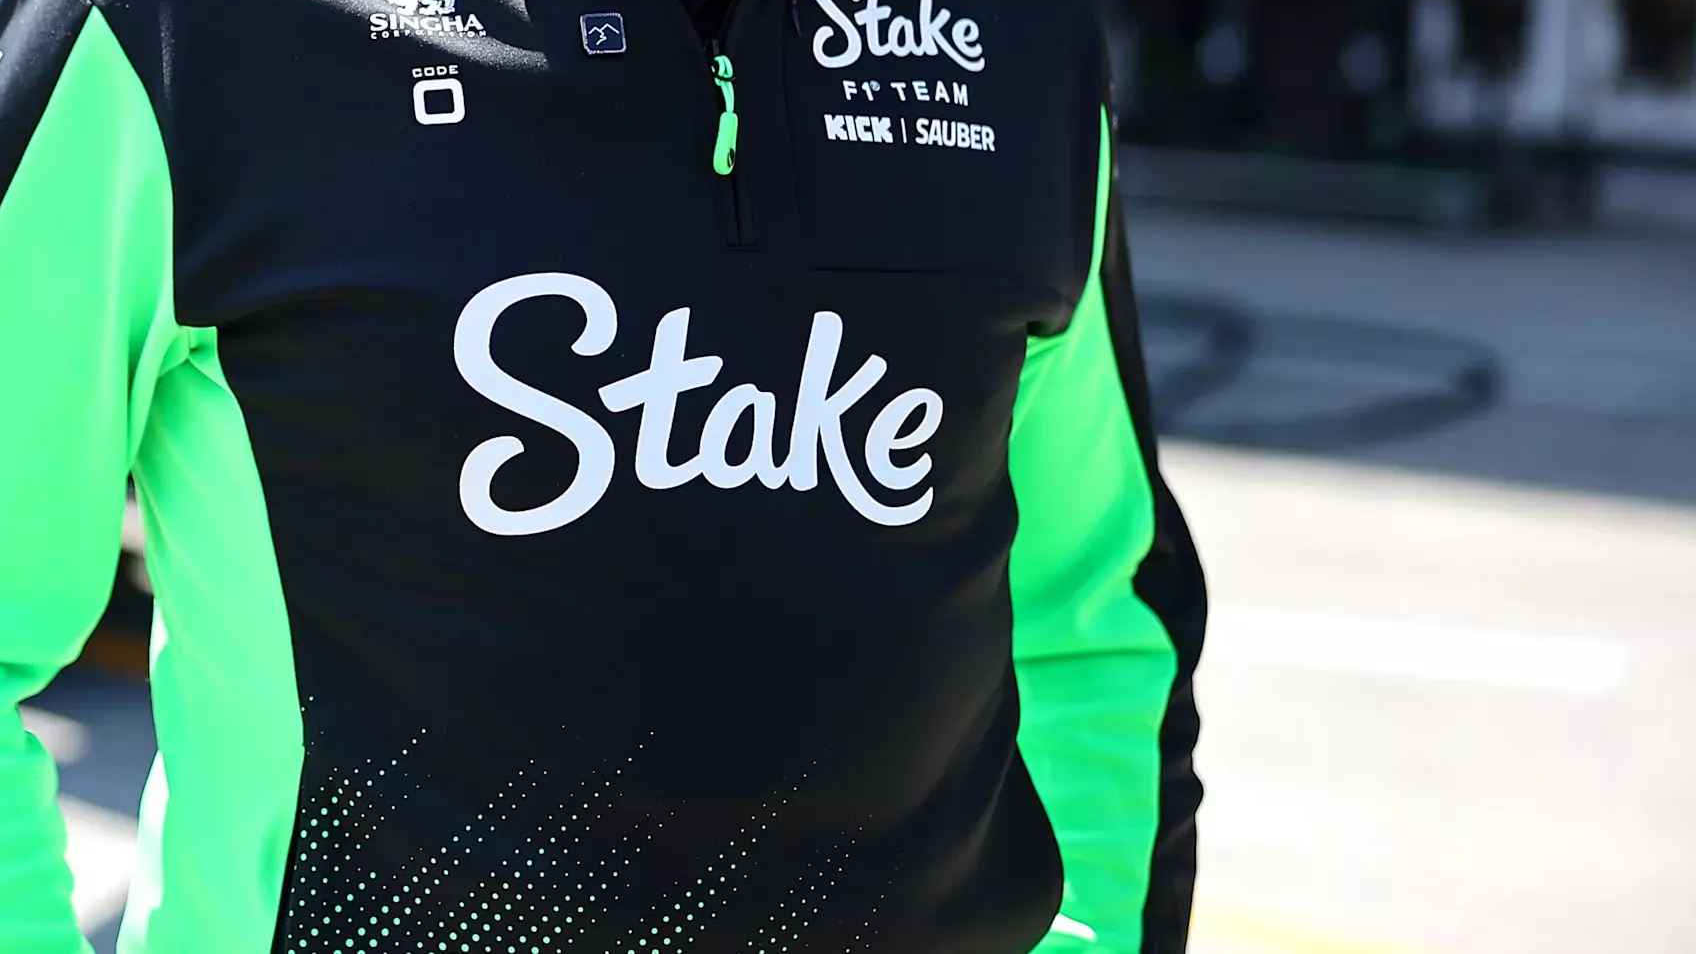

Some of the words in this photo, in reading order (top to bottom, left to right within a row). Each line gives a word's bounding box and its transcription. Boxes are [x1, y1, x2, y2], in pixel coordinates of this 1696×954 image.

[369, 13, 484, 32] SINGHA
[371, 30, 487, 40] CORPORATION
[412, 65, 459, 78] CODE
[890, 80, 968, 106] TEAM
[824, 114, 893, 143] KICK
[915, 118, 995, 151] SAUBER
[454, 272, 943, 536] Stake
